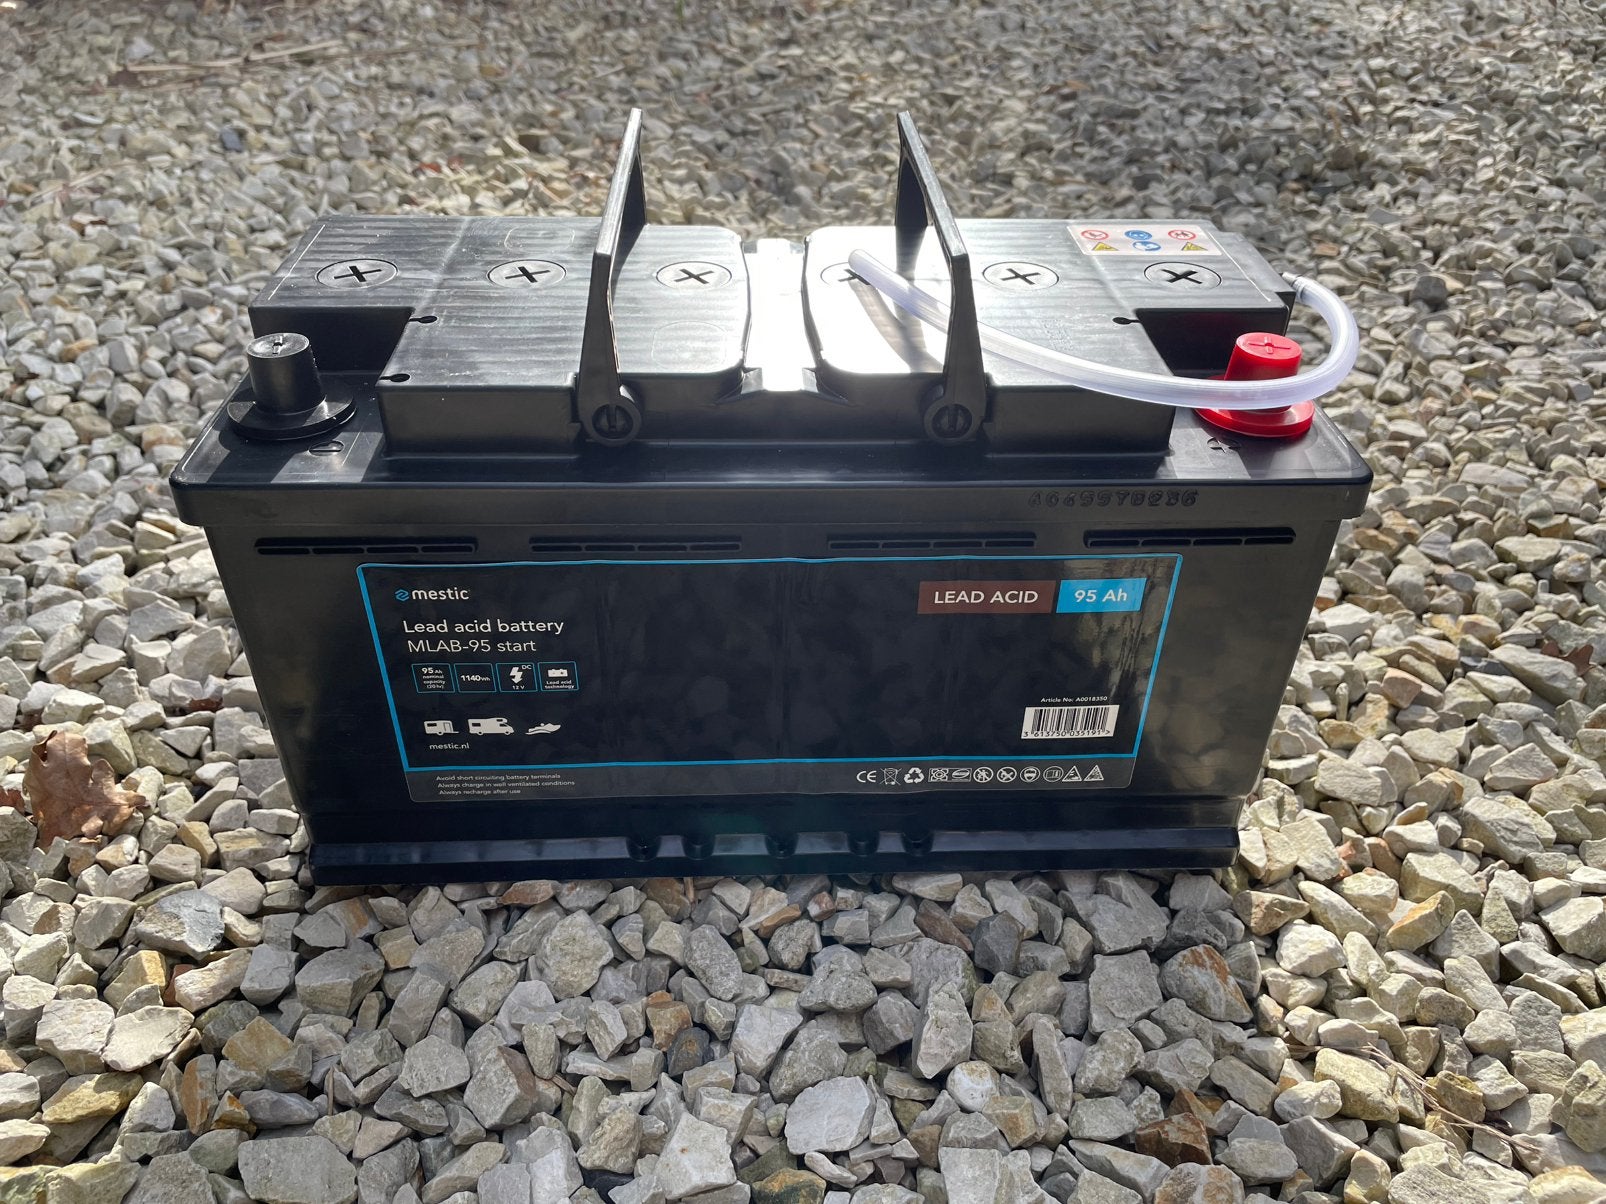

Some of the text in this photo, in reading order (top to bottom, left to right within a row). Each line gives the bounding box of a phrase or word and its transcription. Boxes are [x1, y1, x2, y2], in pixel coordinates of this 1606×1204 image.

[411, 586, 470, 601] mestic
[933, 590, 1039, 604] LEAD ACID
[1073, 589, 1128, 603] 95 Ah
[402, 618, 565, 634] Lead acid battery
[407, 639, 537, 653] MLAB-95 start
[429, 742, 470, 750] mestic.nl
